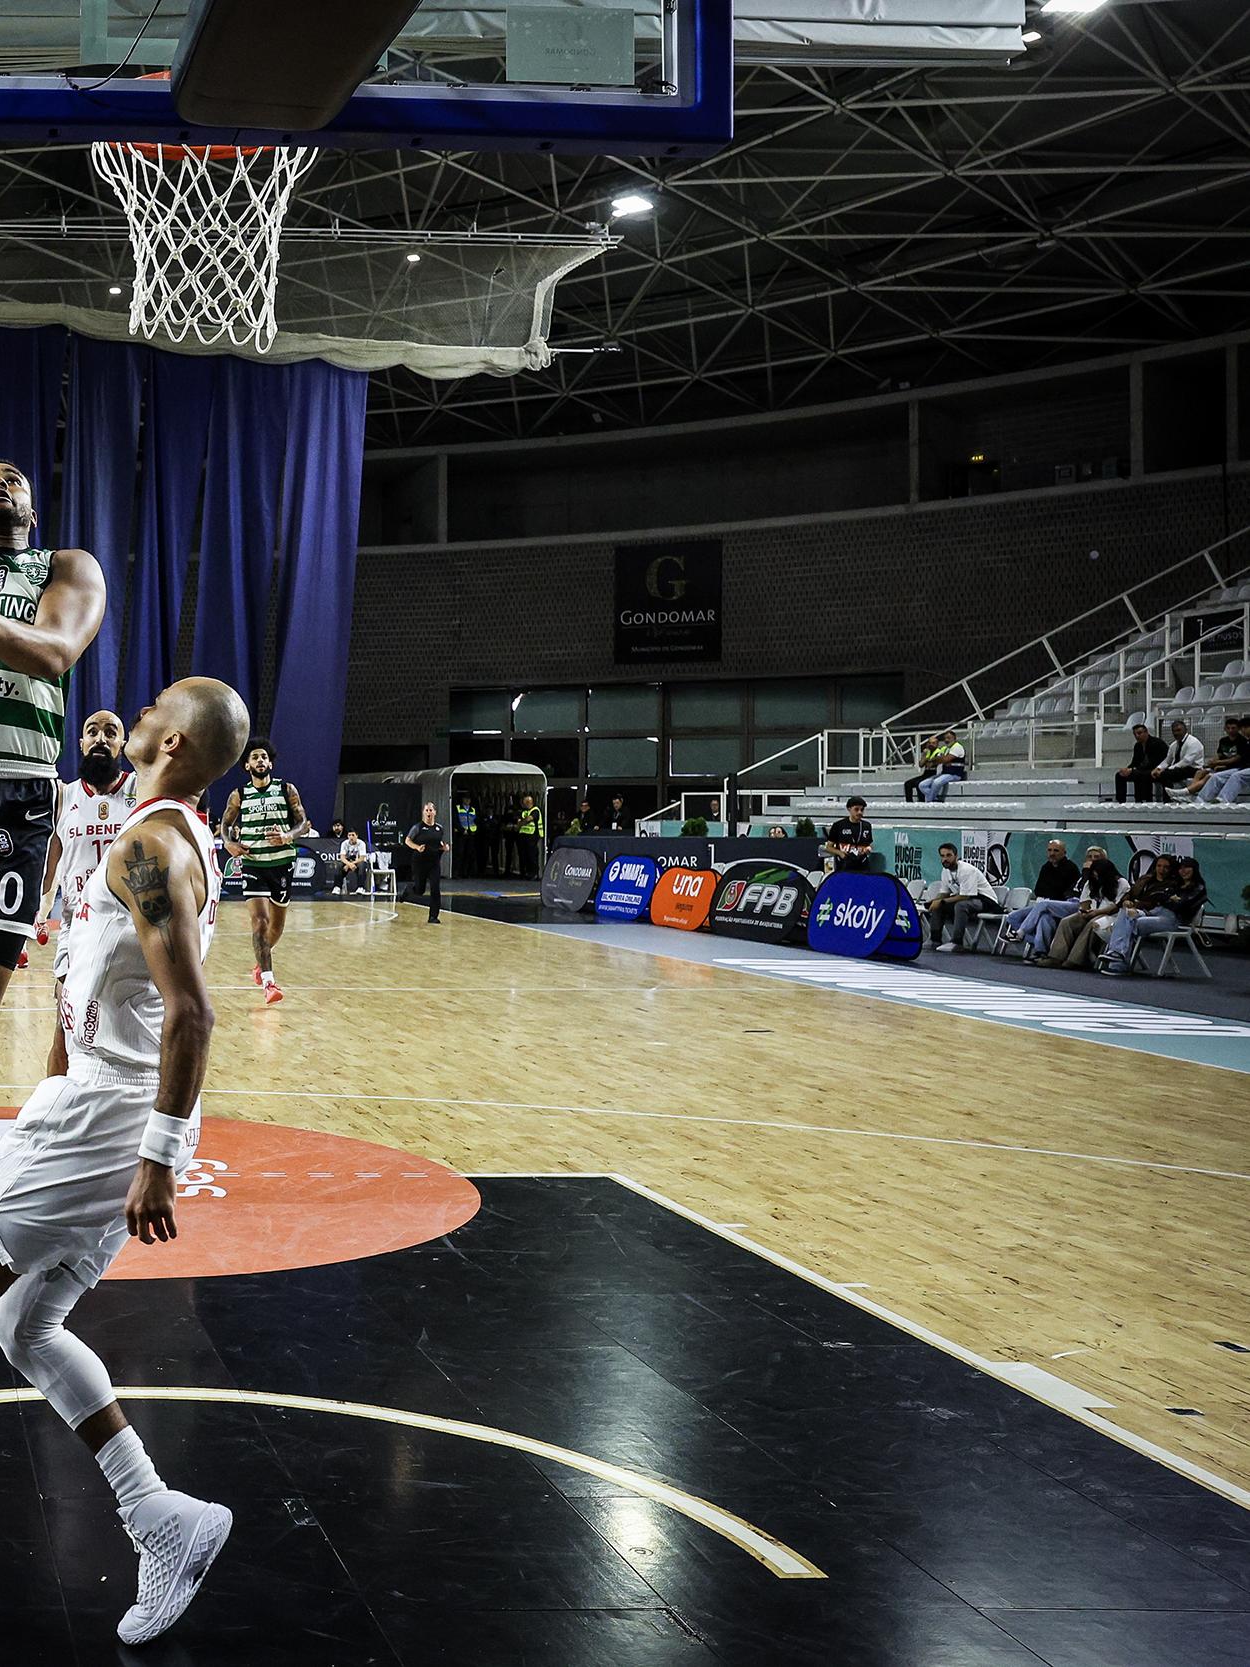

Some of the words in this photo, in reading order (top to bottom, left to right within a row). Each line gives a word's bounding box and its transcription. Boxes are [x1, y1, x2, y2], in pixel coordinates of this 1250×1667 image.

[619, 608, 716, 626] GONDOMAR
[248, 803, 278, 813] SPORTING
[69, 827, 82, 838] SL
[86, 824, 121, 836] BENF
[658, 856, 698, 867] OMAR
[895, 845, 914, 864] HUGO
[619, 863, 645, 880] SMART
[635, 873, 649, 888] FAN
[672, 873, 704, 897] una
[279, 890, 288, 903] 7
[736, 883, 799, 917] FPB
